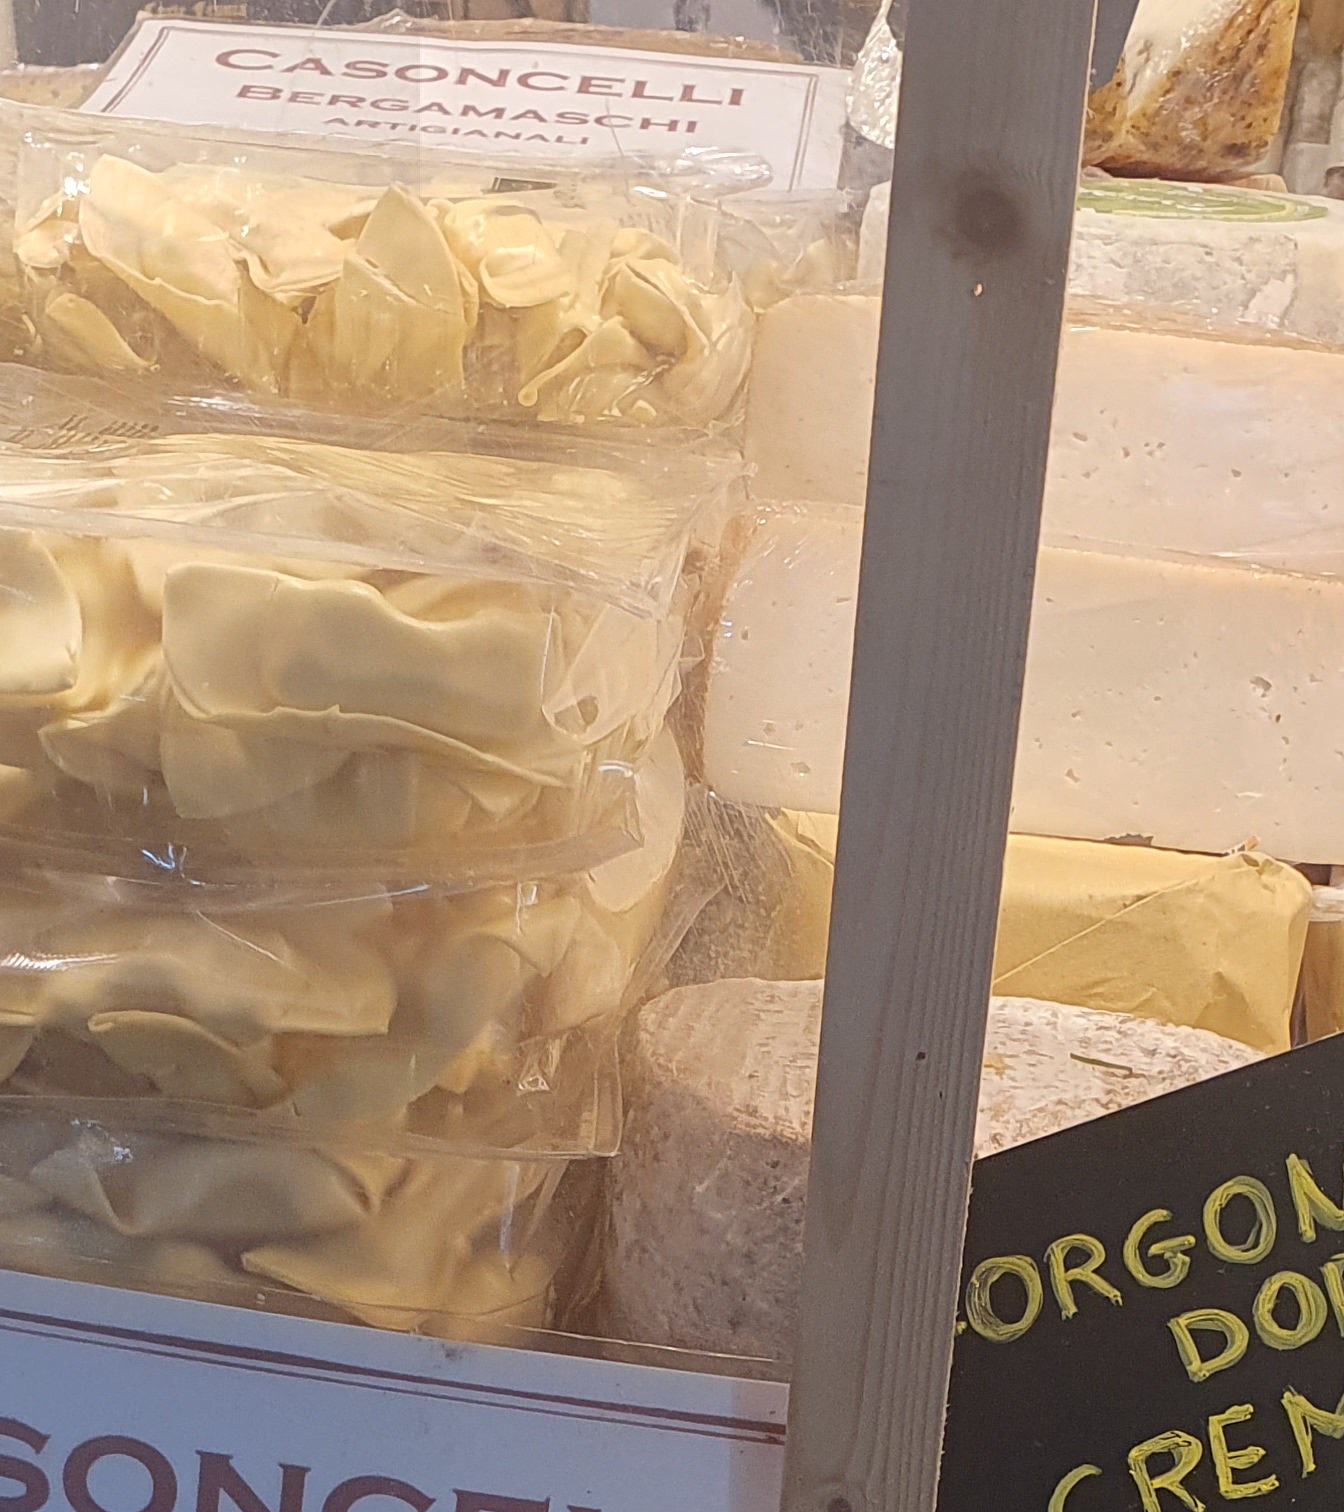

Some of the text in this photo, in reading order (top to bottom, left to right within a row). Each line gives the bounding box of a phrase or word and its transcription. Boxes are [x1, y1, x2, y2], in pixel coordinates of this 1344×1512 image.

[215, 48, 744, 106] CASONCELLI
[236, 84, 697, 133] BERGAMASCHI
[324, 117, 589, 145] ARTIGIANALI
